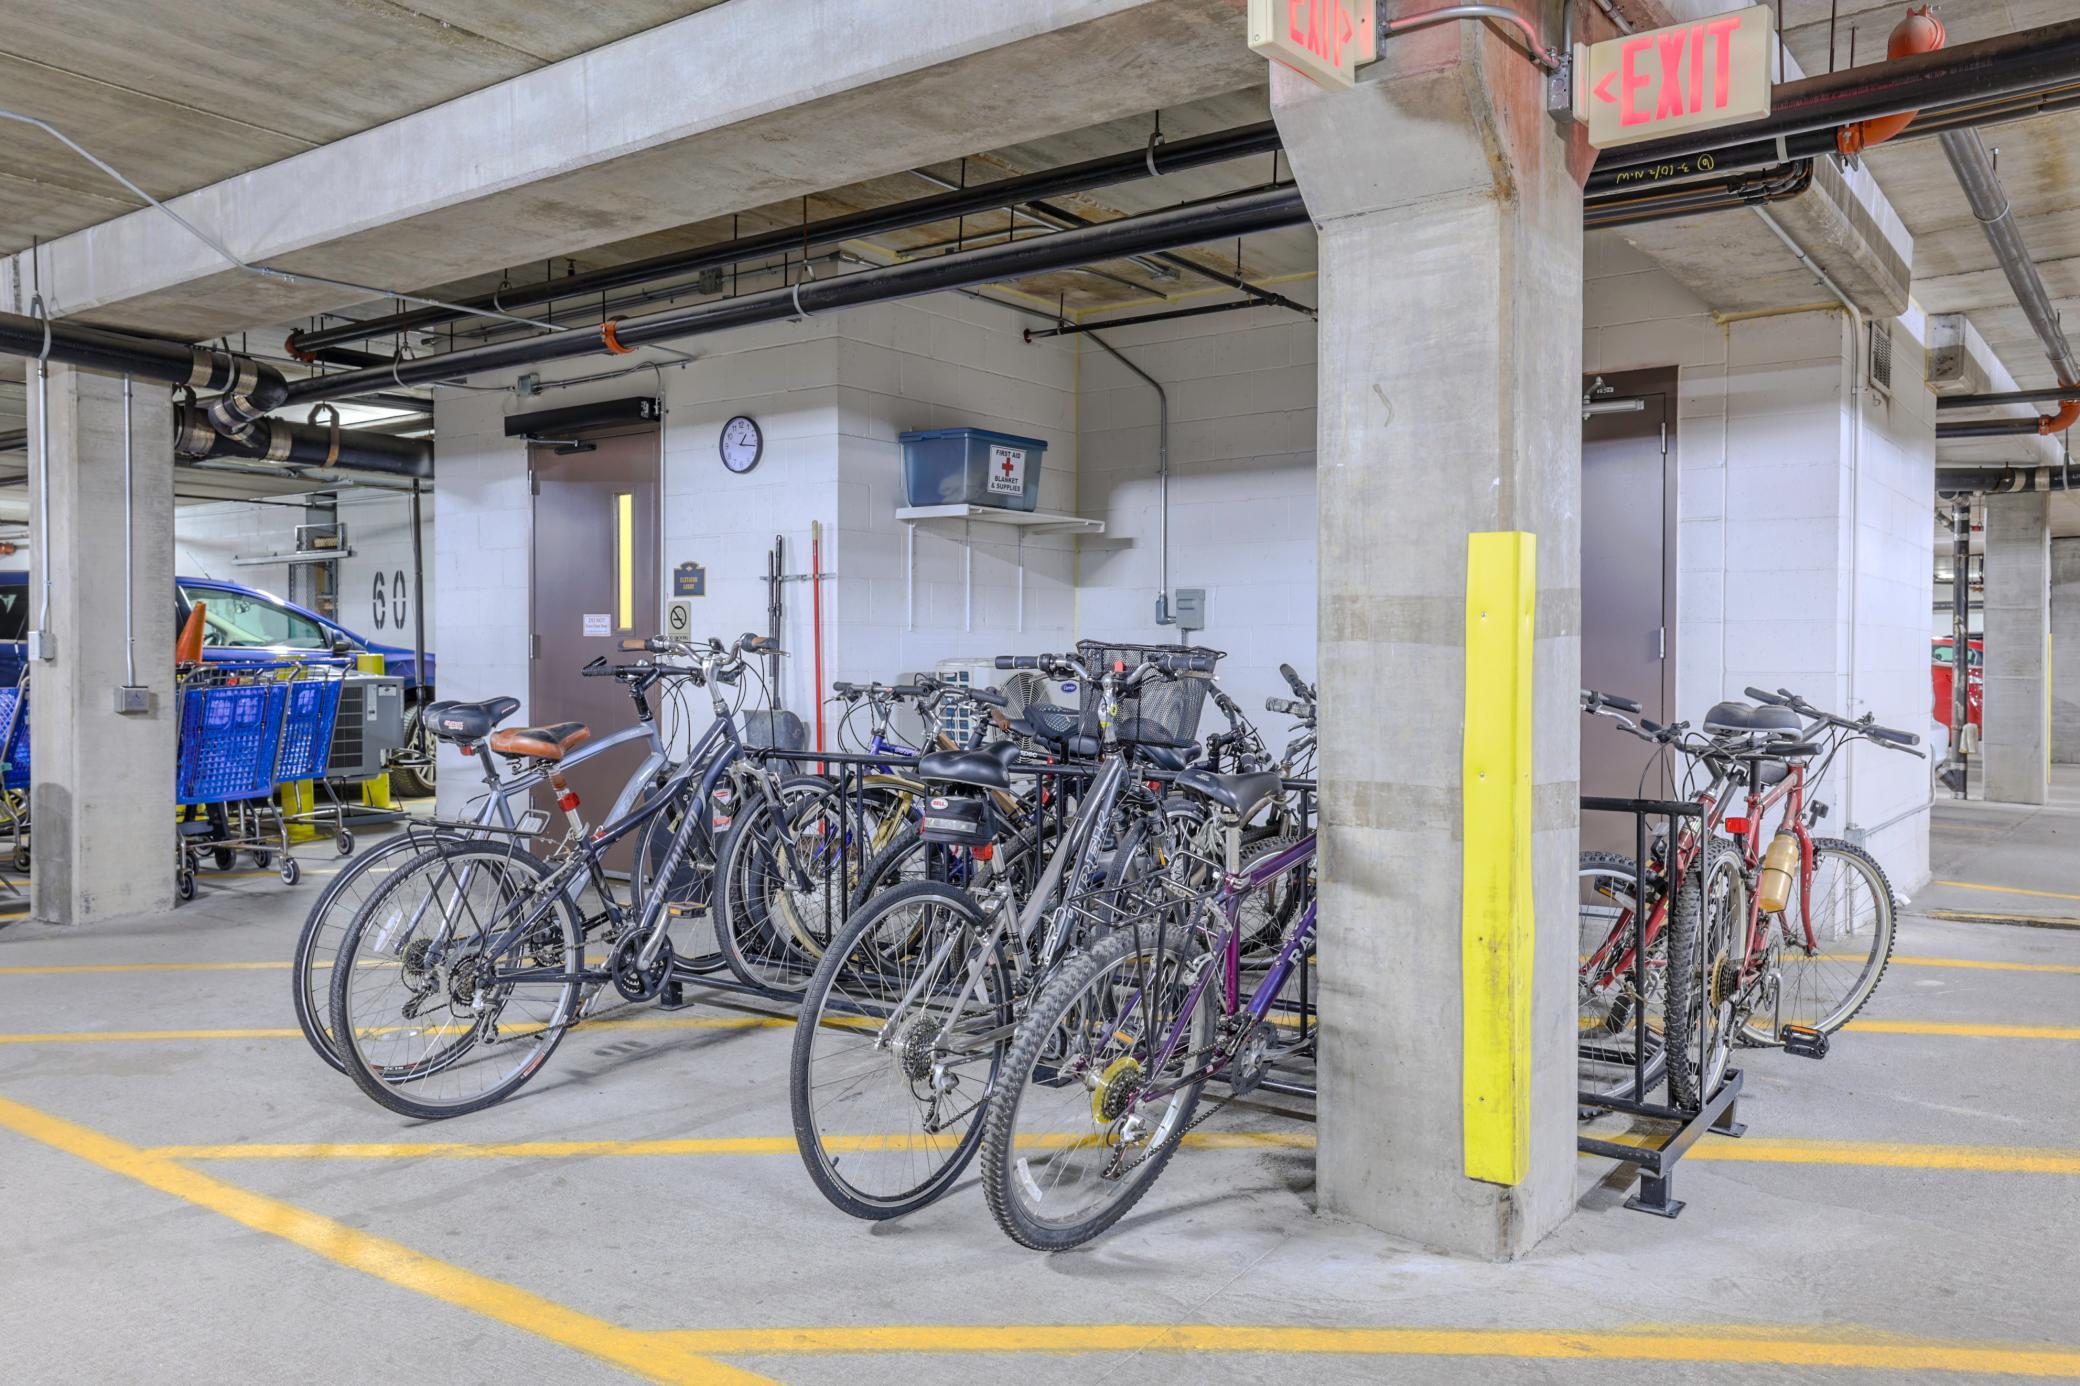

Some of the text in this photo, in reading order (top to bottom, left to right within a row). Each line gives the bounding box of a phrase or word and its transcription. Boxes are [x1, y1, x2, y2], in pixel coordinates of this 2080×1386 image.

[1620, 17, 1741, 127] EXIT
[996, 449, 1021, 459] FIRST AID
[994, 475, 1019, 484] BLANKET
[372, 570, 407, 630] 60
